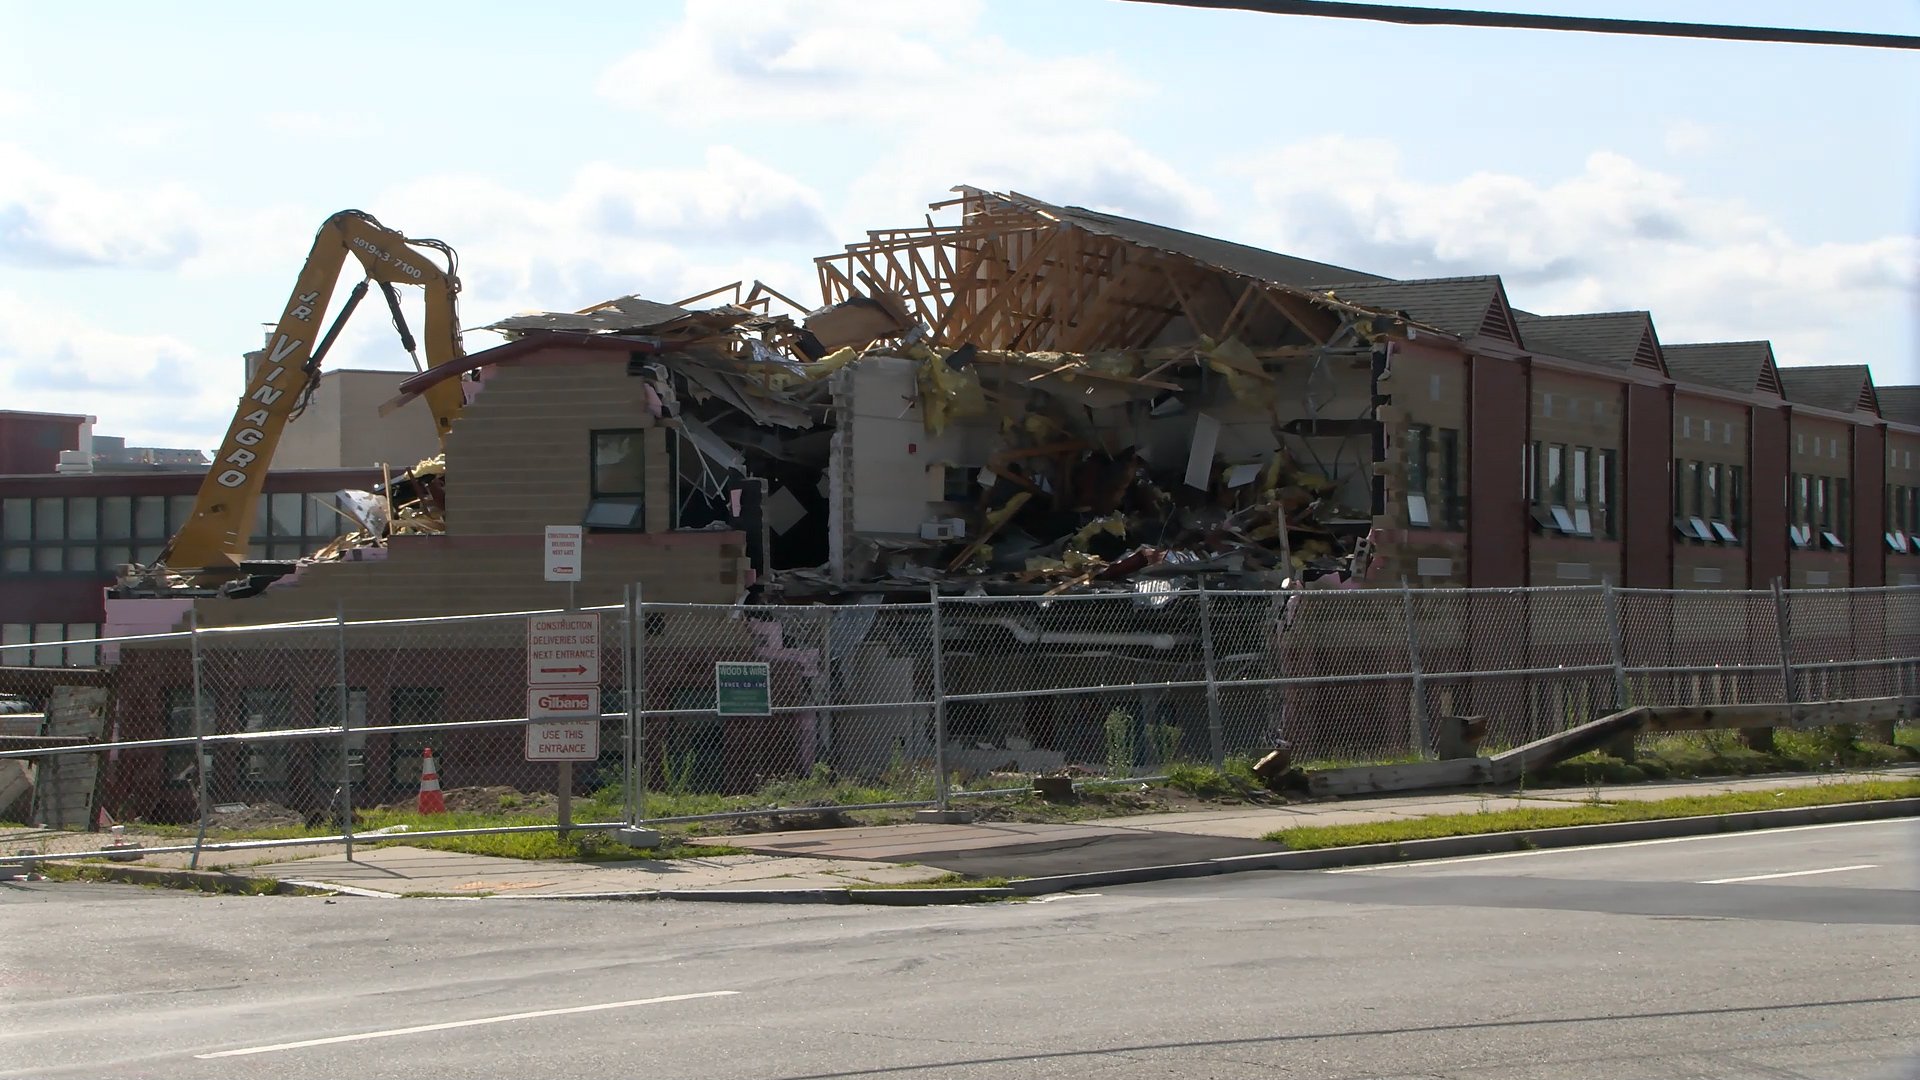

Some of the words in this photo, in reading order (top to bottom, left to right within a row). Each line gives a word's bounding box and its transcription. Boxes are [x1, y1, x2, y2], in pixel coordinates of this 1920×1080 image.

[217, 334, 304, 488] VINAGRO
[536, 621, 592, 631] CONSTRUCTION
[533, 635, 577, 645] DELIVERIES
[580, 635, 595, 644] USE
[533, 650, 553, 660] NEXT
[555, 649, 595, 659] ENTRANCE
[720, 666, 742, 676] WOOD
[743, 666, 748, 676] &
[749, 666, 767, 676] WIRE
[538, 695, 588, 709] Gilbane
[542, 730, 560, 740] USE
[564, 730, 584, 739] THIS
[539, 744, 586, 753] ENTRANCE
